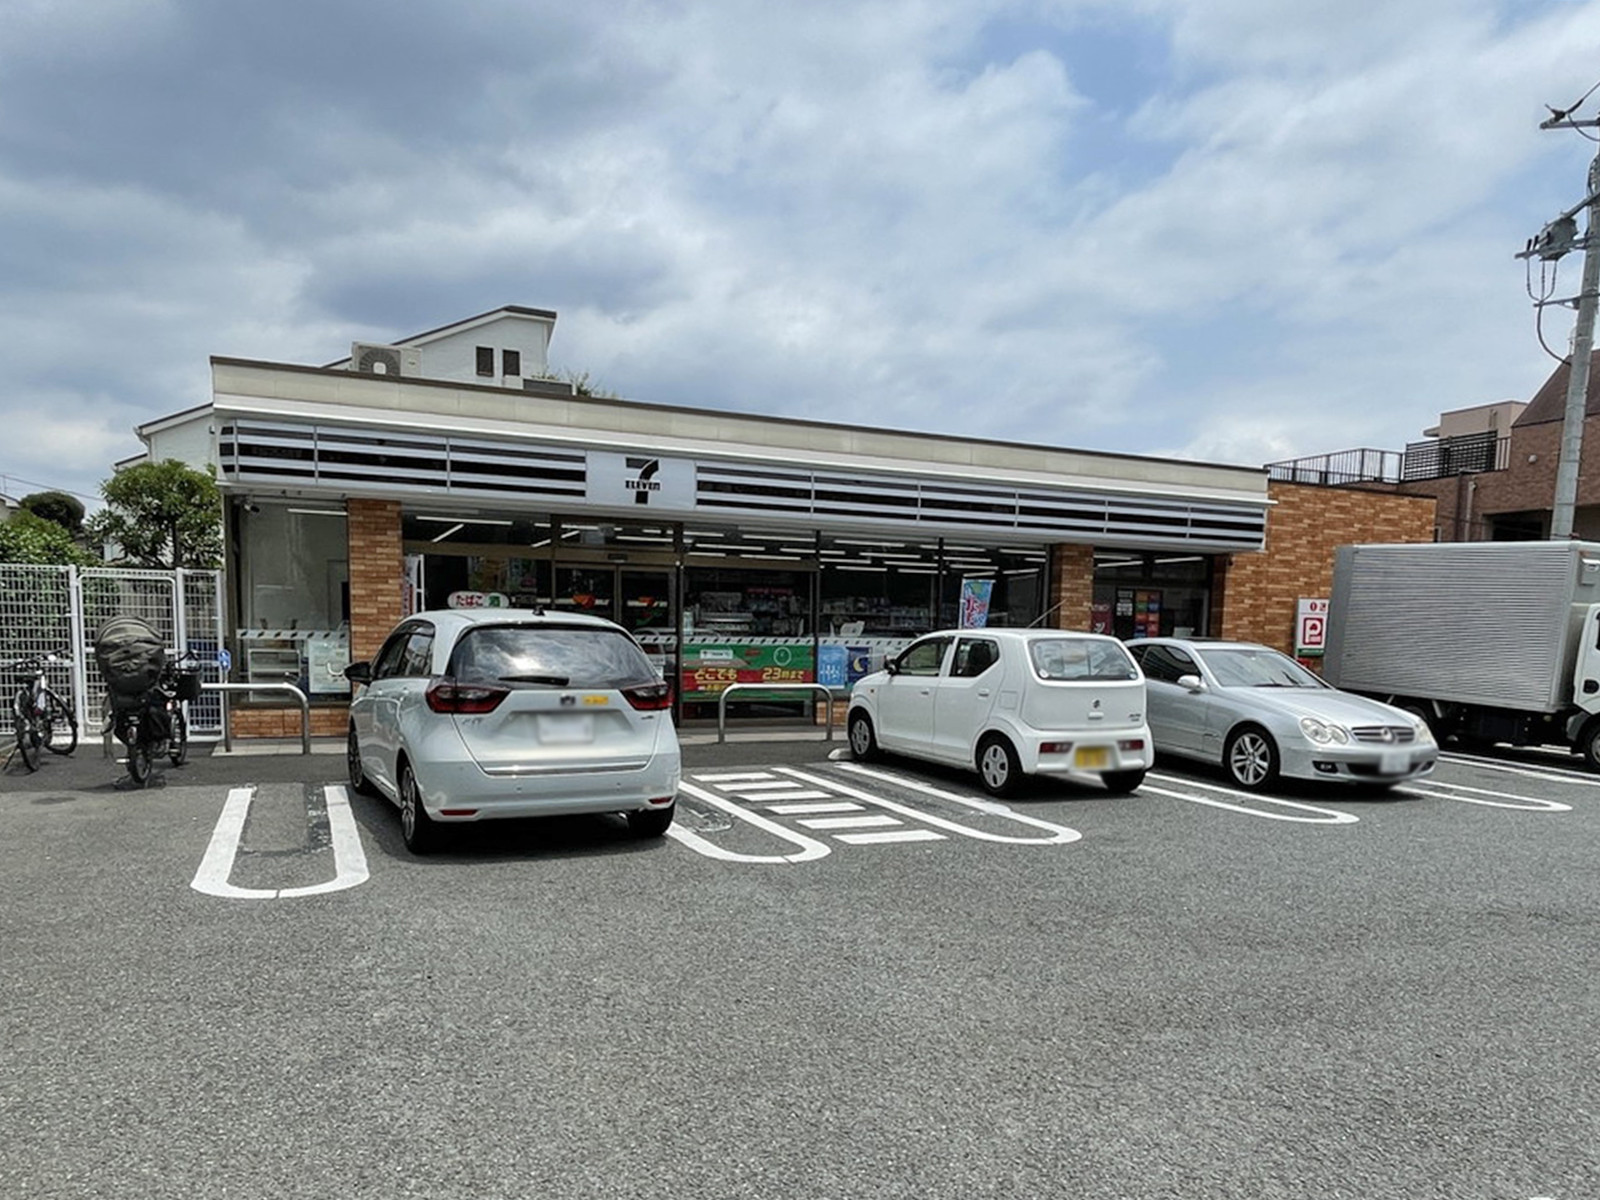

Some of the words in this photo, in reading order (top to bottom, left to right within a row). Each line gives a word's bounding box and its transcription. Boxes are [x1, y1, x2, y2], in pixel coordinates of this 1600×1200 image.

[625, 457, 659, 504] 7
[456, 595, 483, 606] たばこ
[694, 668, 737, 680] どこでも
